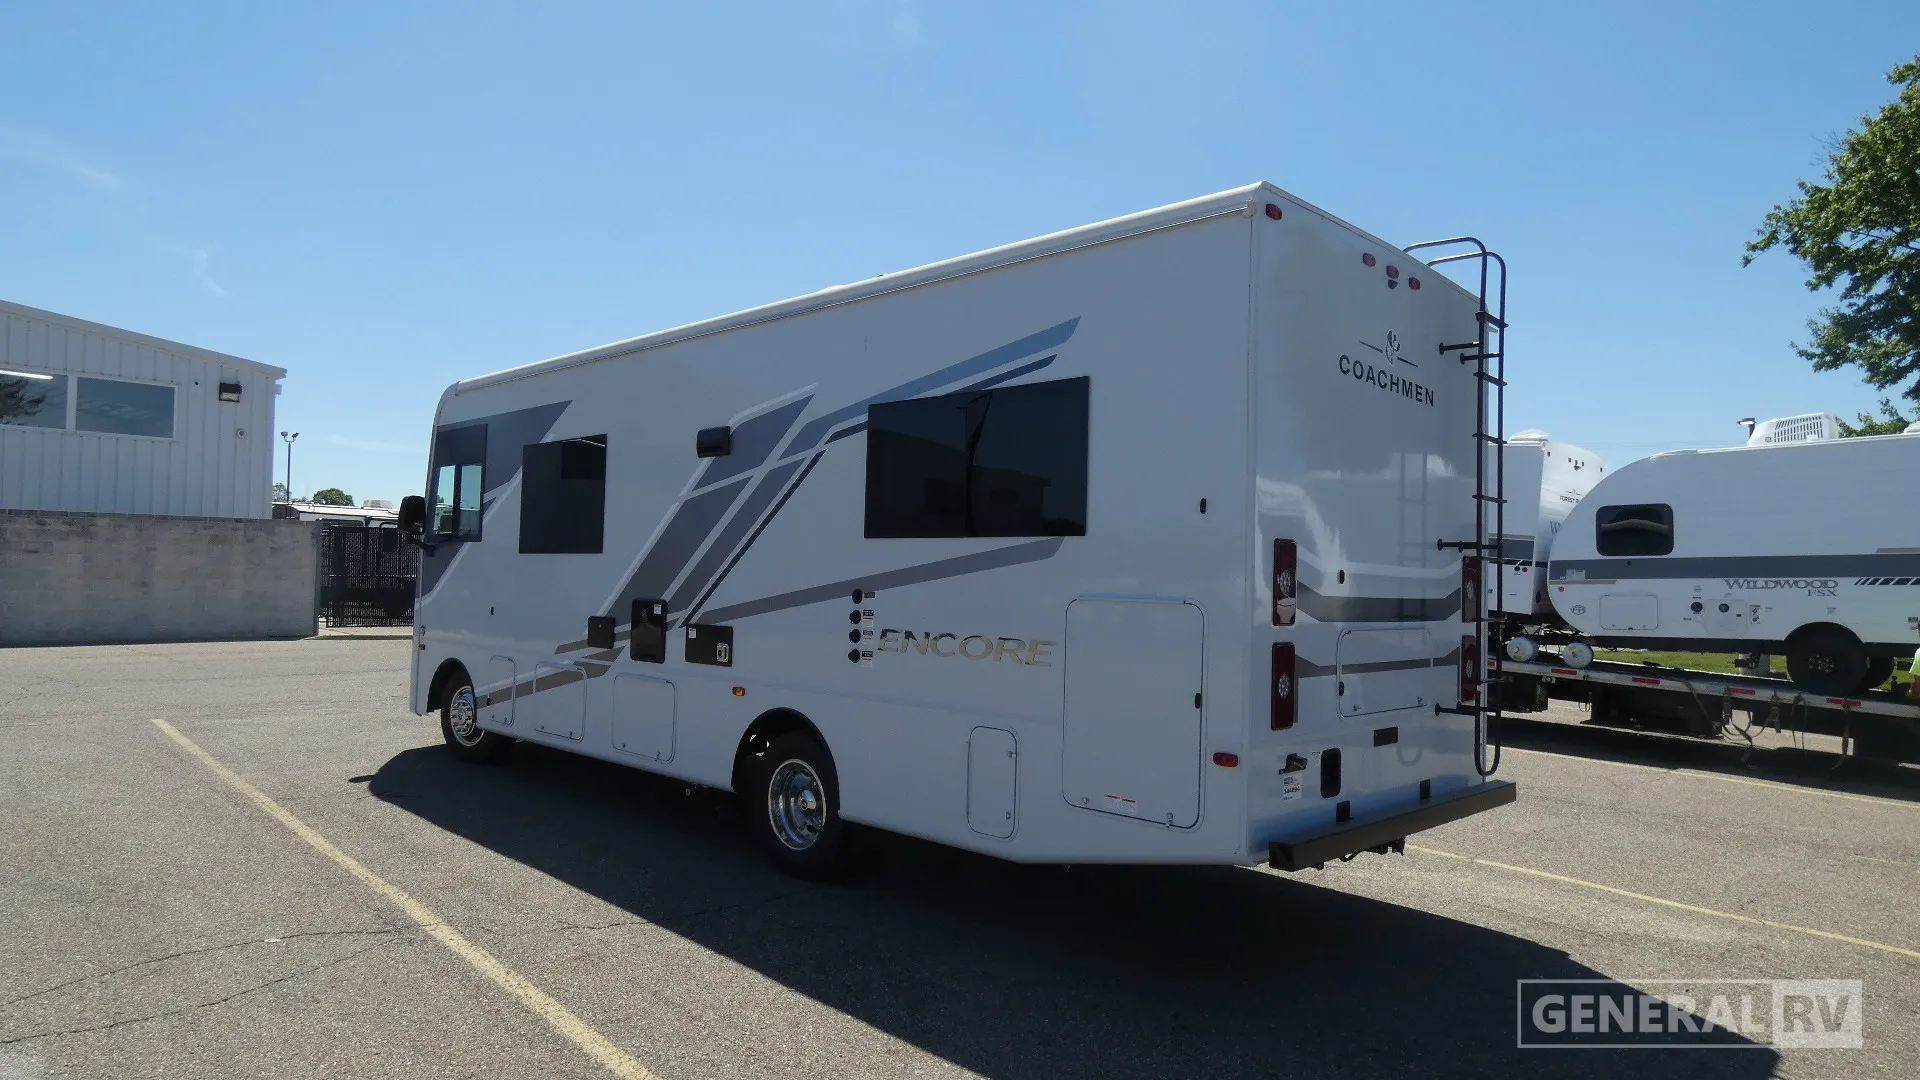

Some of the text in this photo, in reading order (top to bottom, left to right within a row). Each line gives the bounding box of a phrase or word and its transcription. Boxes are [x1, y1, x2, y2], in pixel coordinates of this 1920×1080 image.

[1339, 354, 1434, 407] COACHMEN
[1723, 579, 1839, 590] WILDWOOD
[1807, 589, 1838, 597] FSX
[877, 628, 1057, 668] ENCORE
